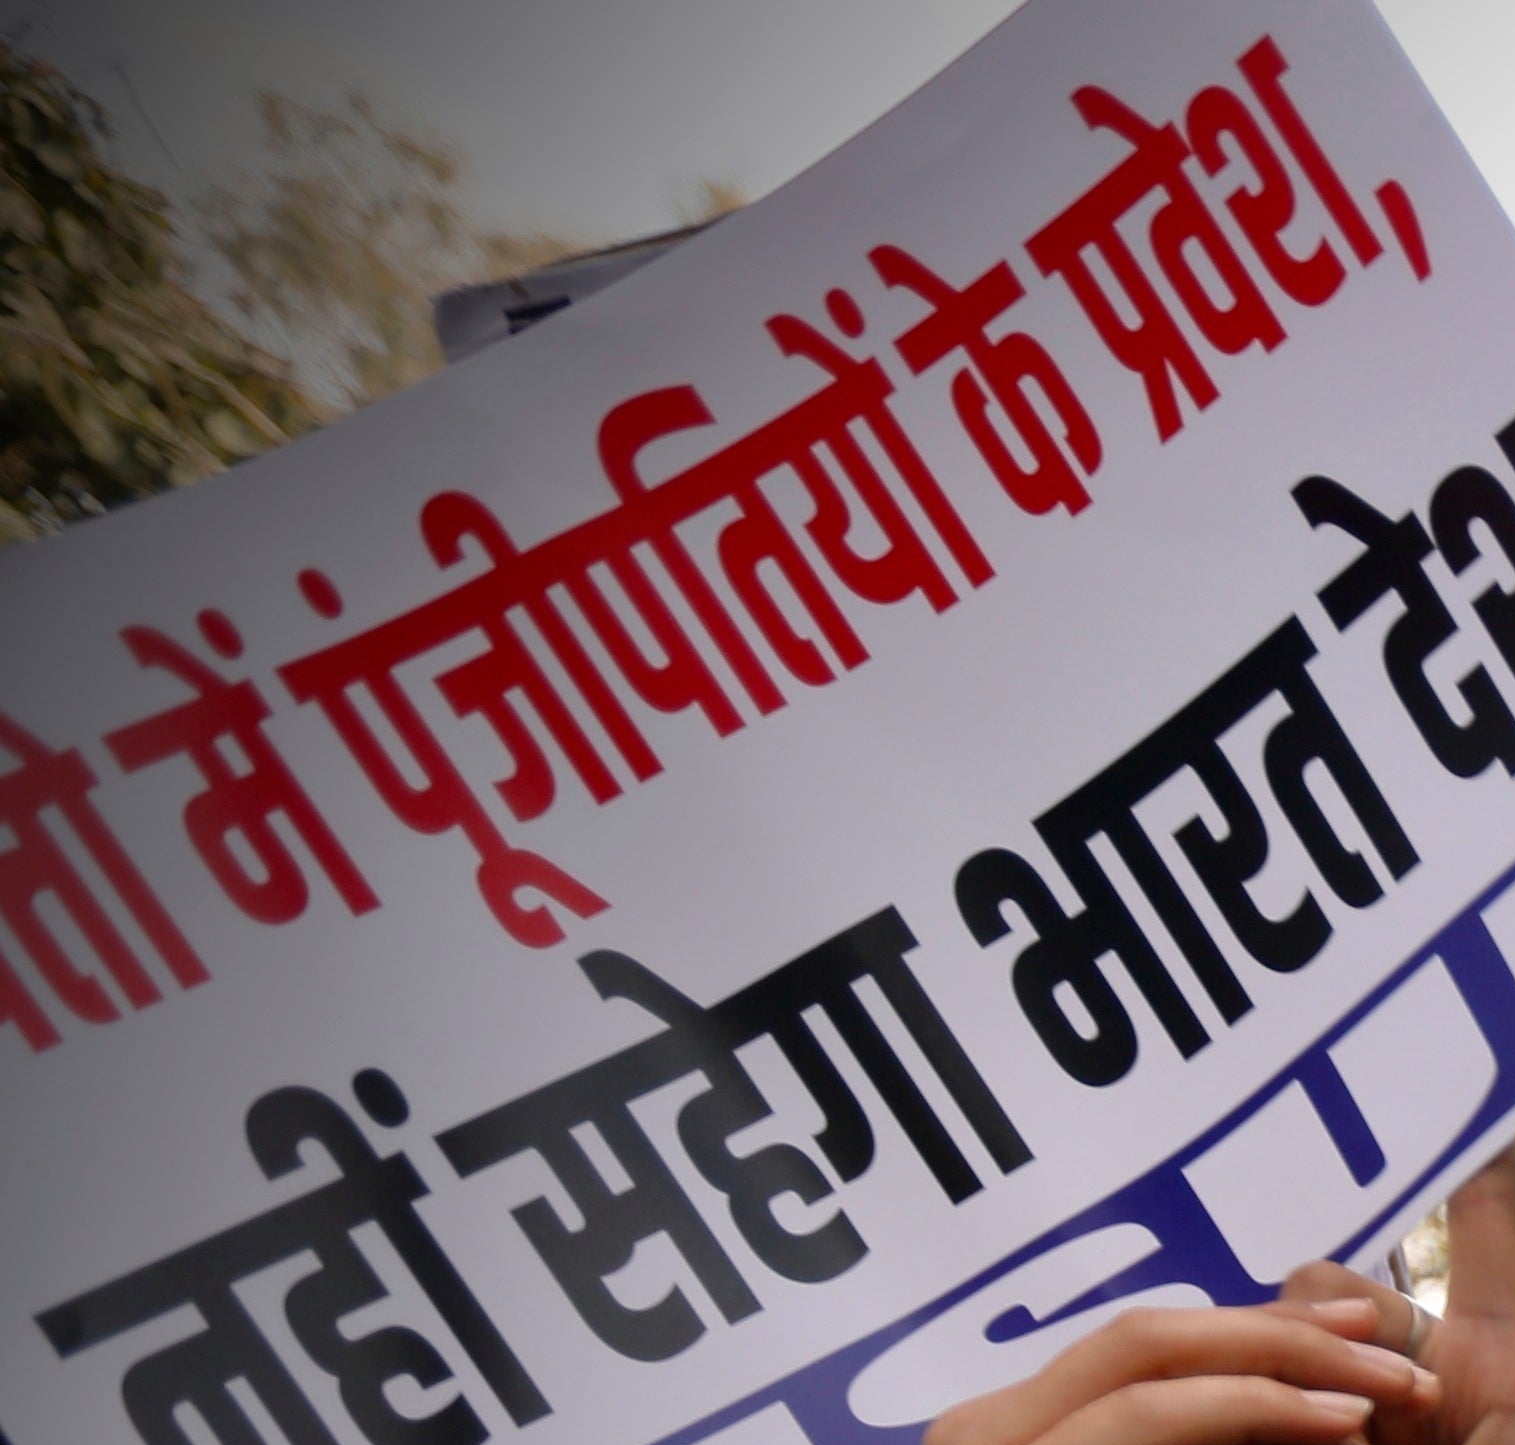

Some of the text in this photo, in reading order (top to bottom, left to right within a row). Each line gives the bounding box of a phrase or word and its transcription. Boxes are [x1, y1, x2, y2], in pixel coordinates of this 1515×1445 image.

[102, 604, 383, 926] में
[867, 243, 1104, 519] के
[1022, 33, 1433, 446] प्रवेश,
[433, 902, 1036, 1364] सहेगा
[952, 613, 1422, 1089] भारत
